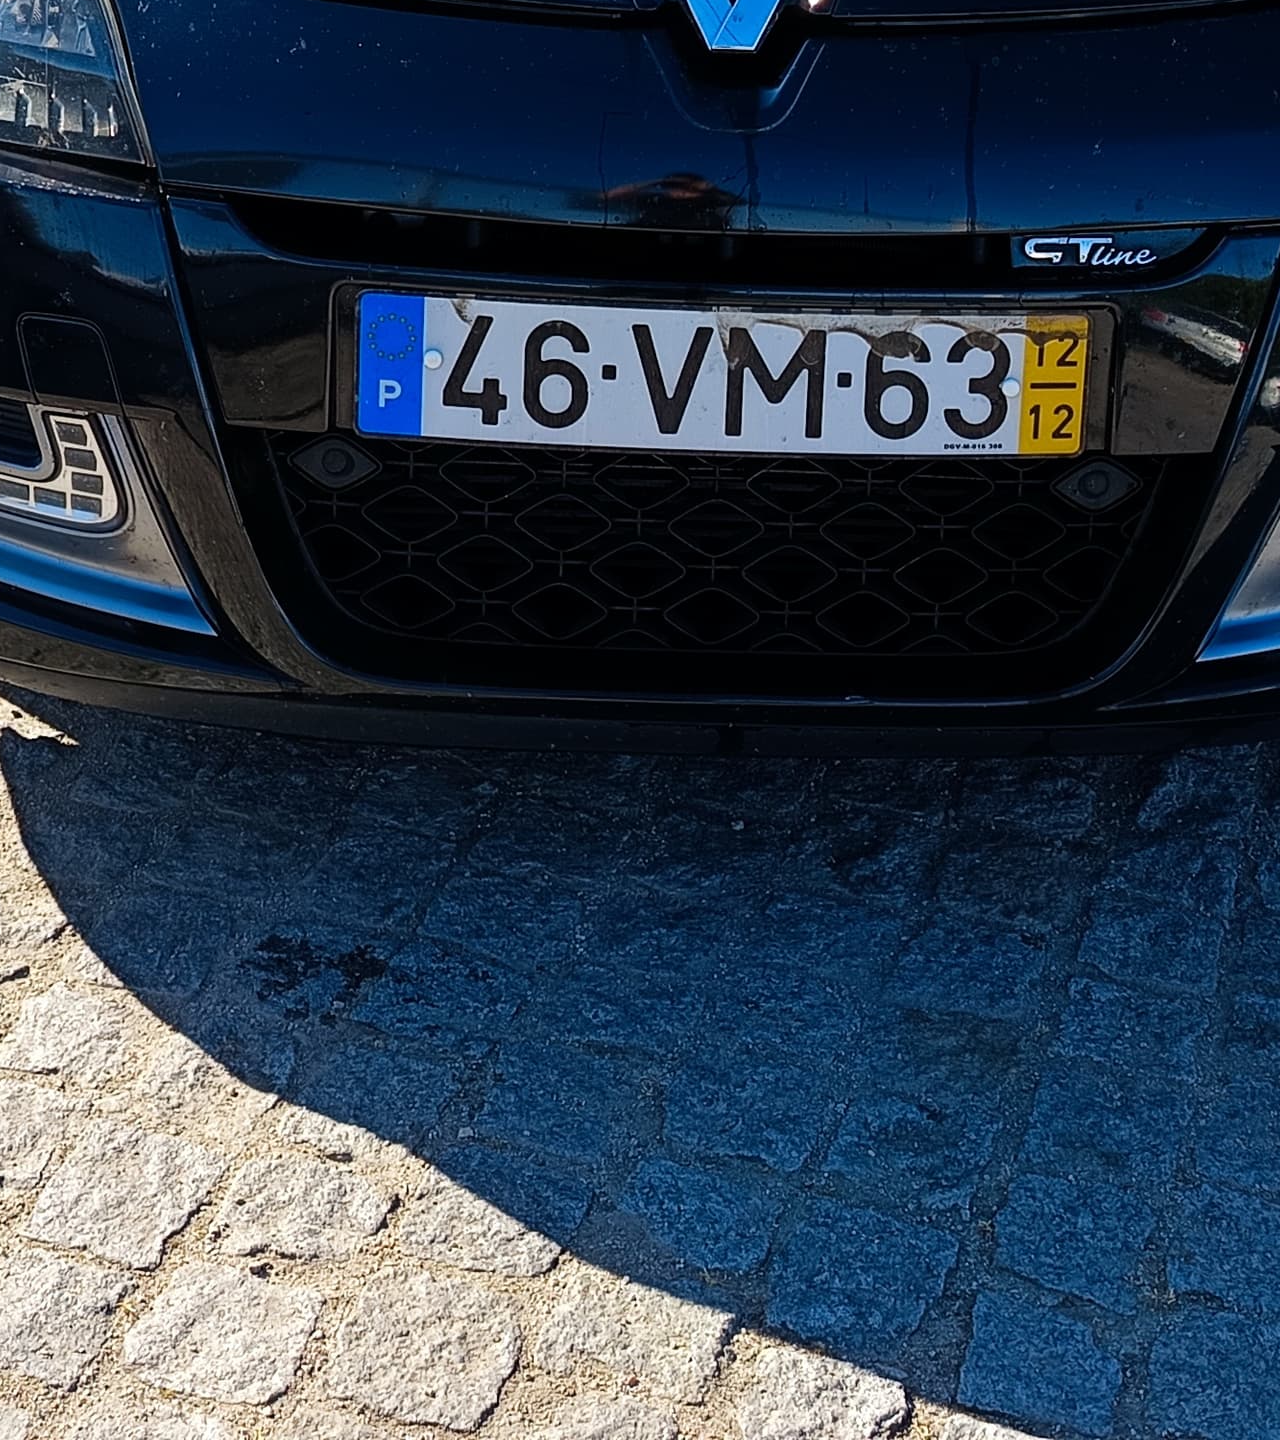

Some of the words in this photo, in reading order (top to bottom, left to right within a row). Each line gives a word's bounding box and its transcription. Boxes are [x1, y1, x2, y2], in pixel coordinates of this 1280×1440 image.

[1033, 331, 1080, 367] 12
[378, 379, 402, 408] P
[1029, 404, 1075, 440] 12
